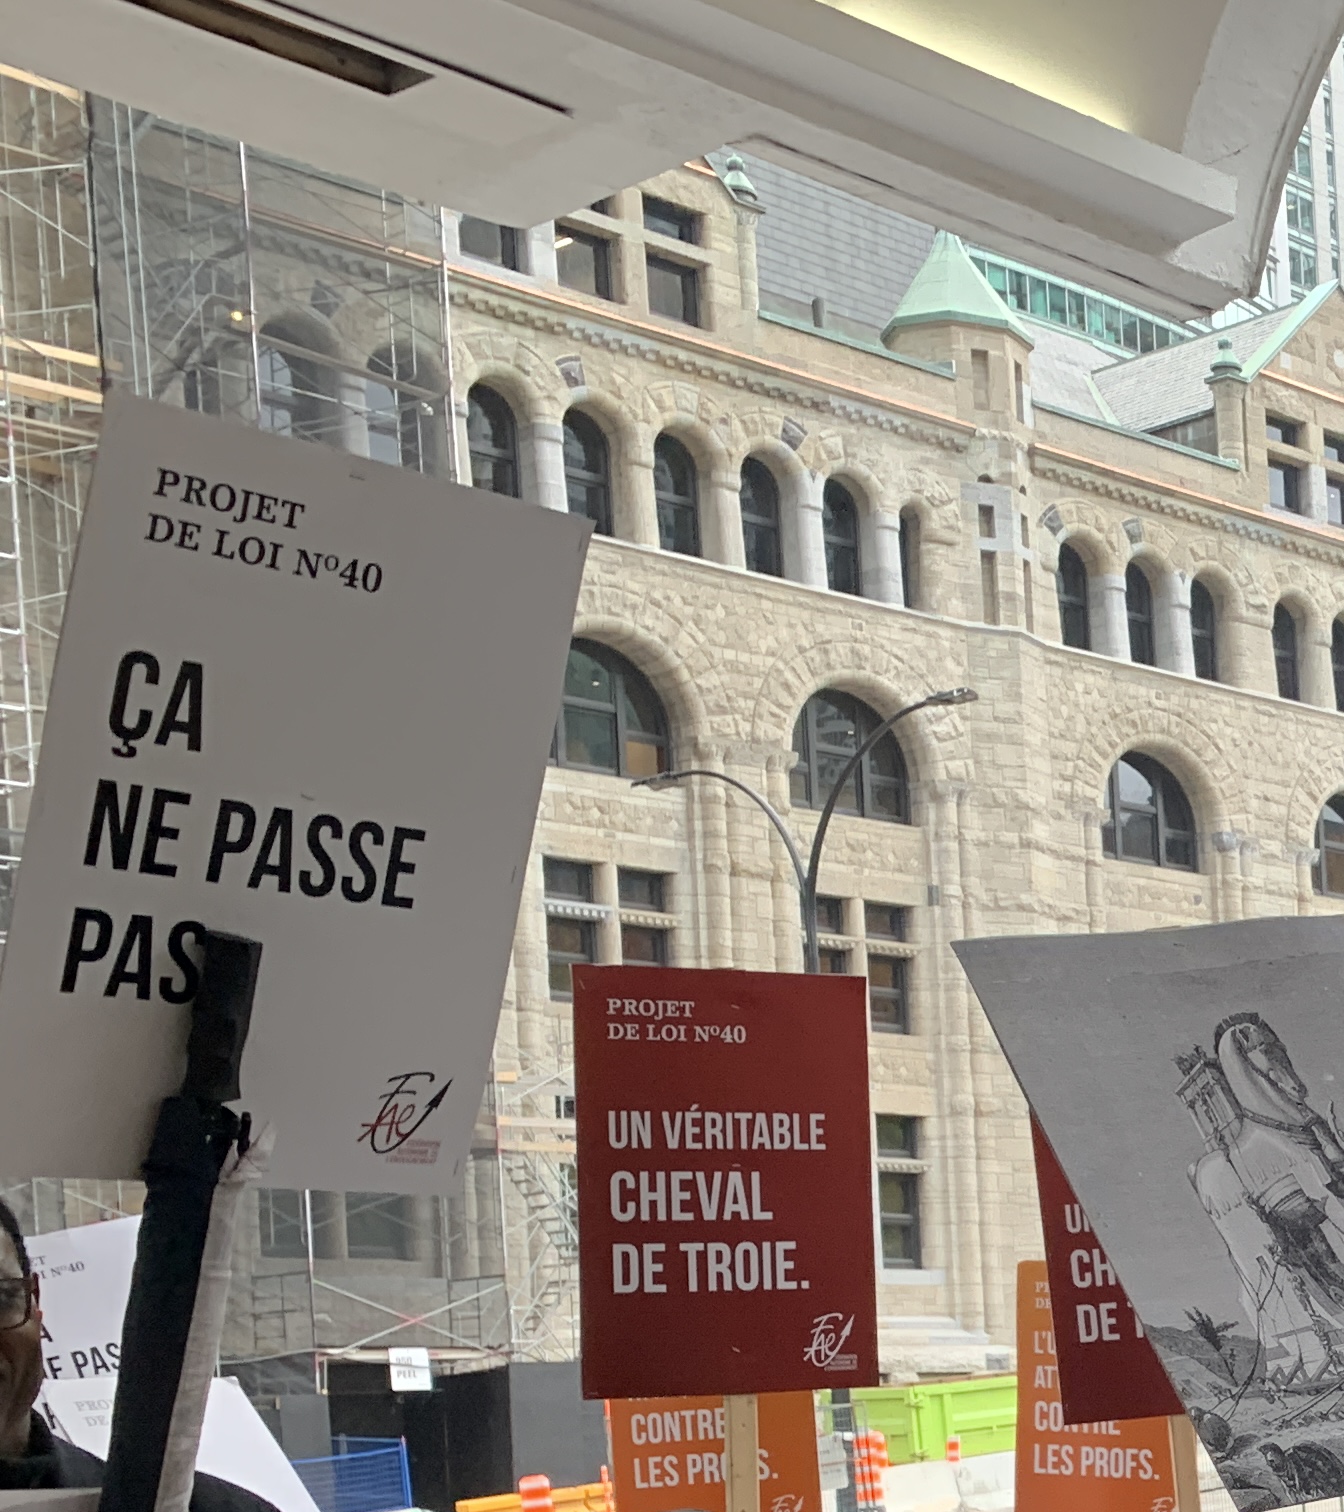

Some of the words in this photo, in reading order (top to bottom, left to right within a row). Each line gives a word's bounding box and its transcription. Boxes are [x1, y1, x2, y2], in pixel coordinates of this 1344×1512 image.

[153, 467, 306, 529] PROJET
[144, 512, 202, 552] DE
[211, 529, 284, 571] LOI
[108, 650, 205, 757] ÇA
[83, 778, 192, 878] NE
[205, 799, 426, 909] PASSE
[60, 906, 208, 1005] PAS
[606, 998, 695, 1020] PROJET
[607, 1022, 640, 1040] DE
[646, 1024, 687, 1042] LOI
[608, 1110, 652, 1150] UN
[662, 1104, 827, 1151] VÉRITABLE
[609, 1170, 774, 1222] CHEVAL
[612, 1242, 667, 1294] DE
[679, 1240, 810, 1293] TROIE.
[1076, 1302, 1120, 1343] DE
[634, 1455, 679, 1489] LES
[687, 1448, 779, 1486] PRS.
[1034, 1443, 1074, 1476] LES
[1080, 1446, 1161, 1480] PROFS.
